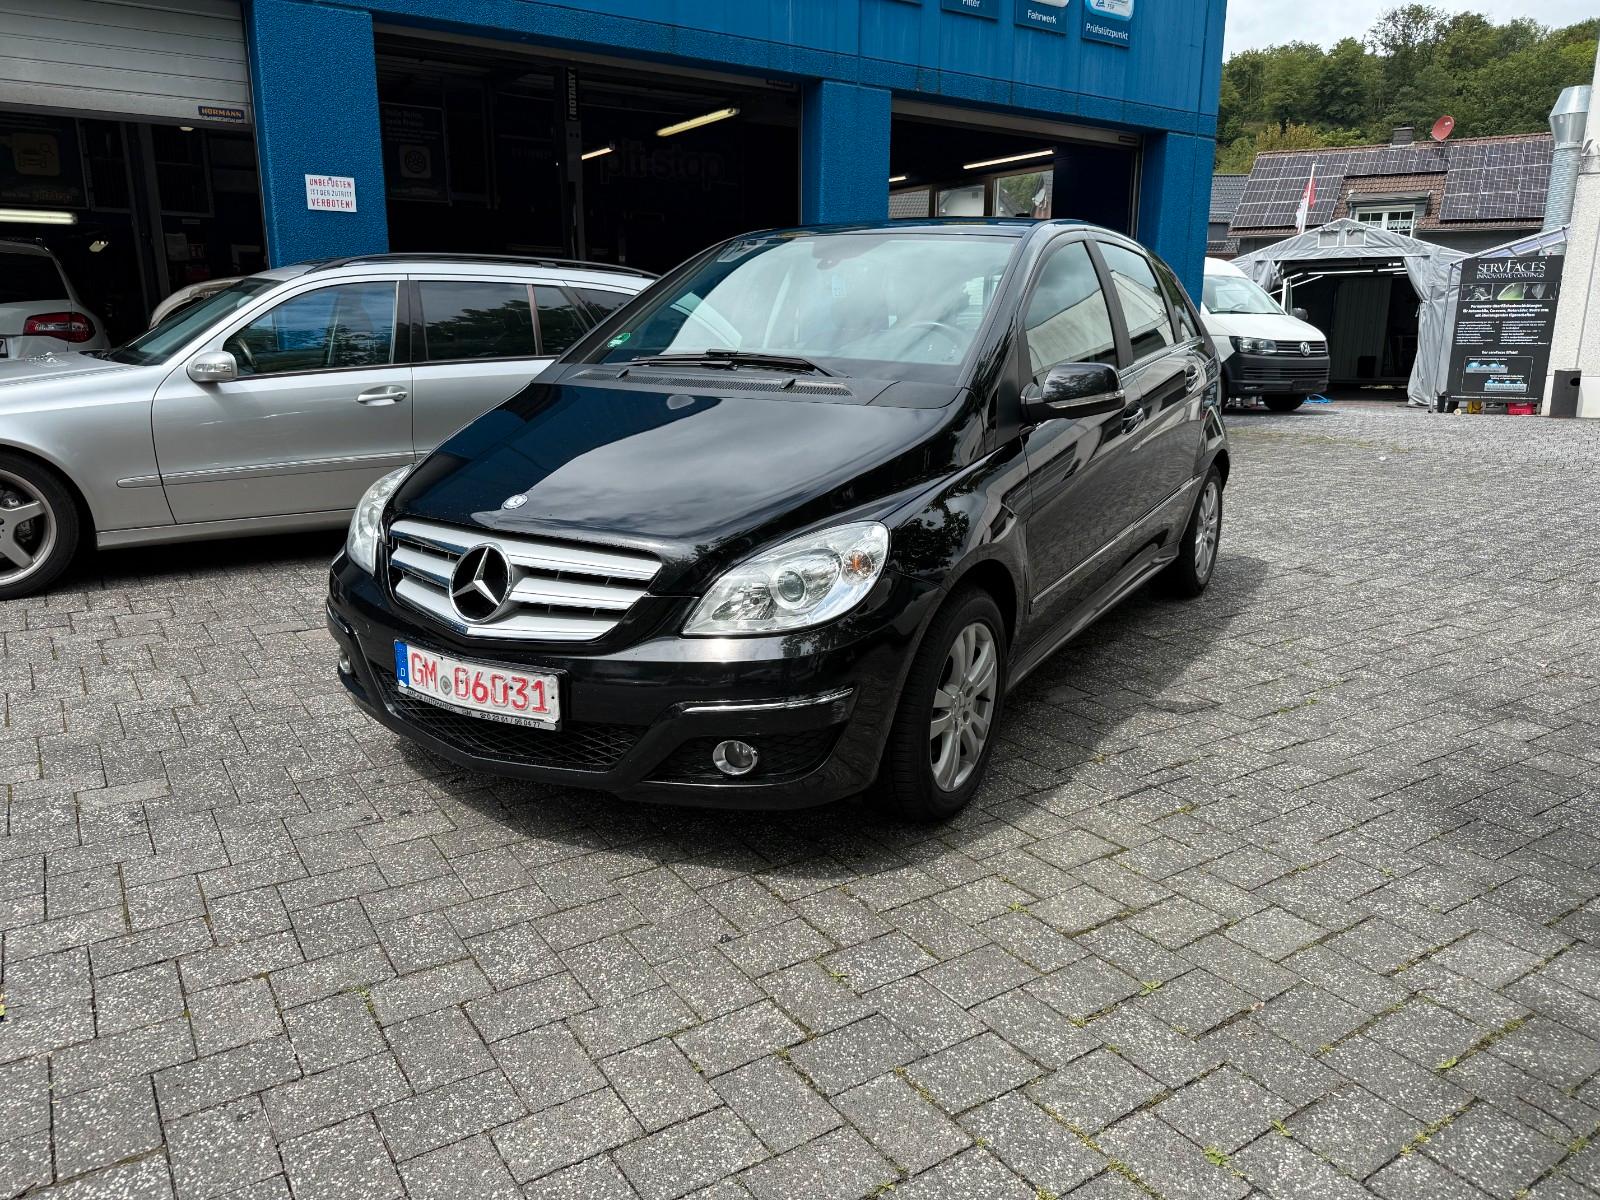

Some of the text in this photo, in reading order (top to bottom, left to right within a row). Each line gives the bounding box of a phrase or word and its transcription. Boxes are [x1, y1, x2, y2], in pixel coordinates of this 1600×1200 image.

[1027, 9, 1057, 24] Fahrwerk
[1086, 22, 1129, 40] Prüfstützpunkt
[309, 178, 352, 188] UNBEFUGTEN
[320, 189, 331, 197] DER
[310, 198, 353, 209] VERBOTEN!
[1478, 259, 1546, 273] SERVFACES
[1476, 270, 1545, 279] INNOVATIVE COATINGS
[411, 652, 550, 715] GM 06031
